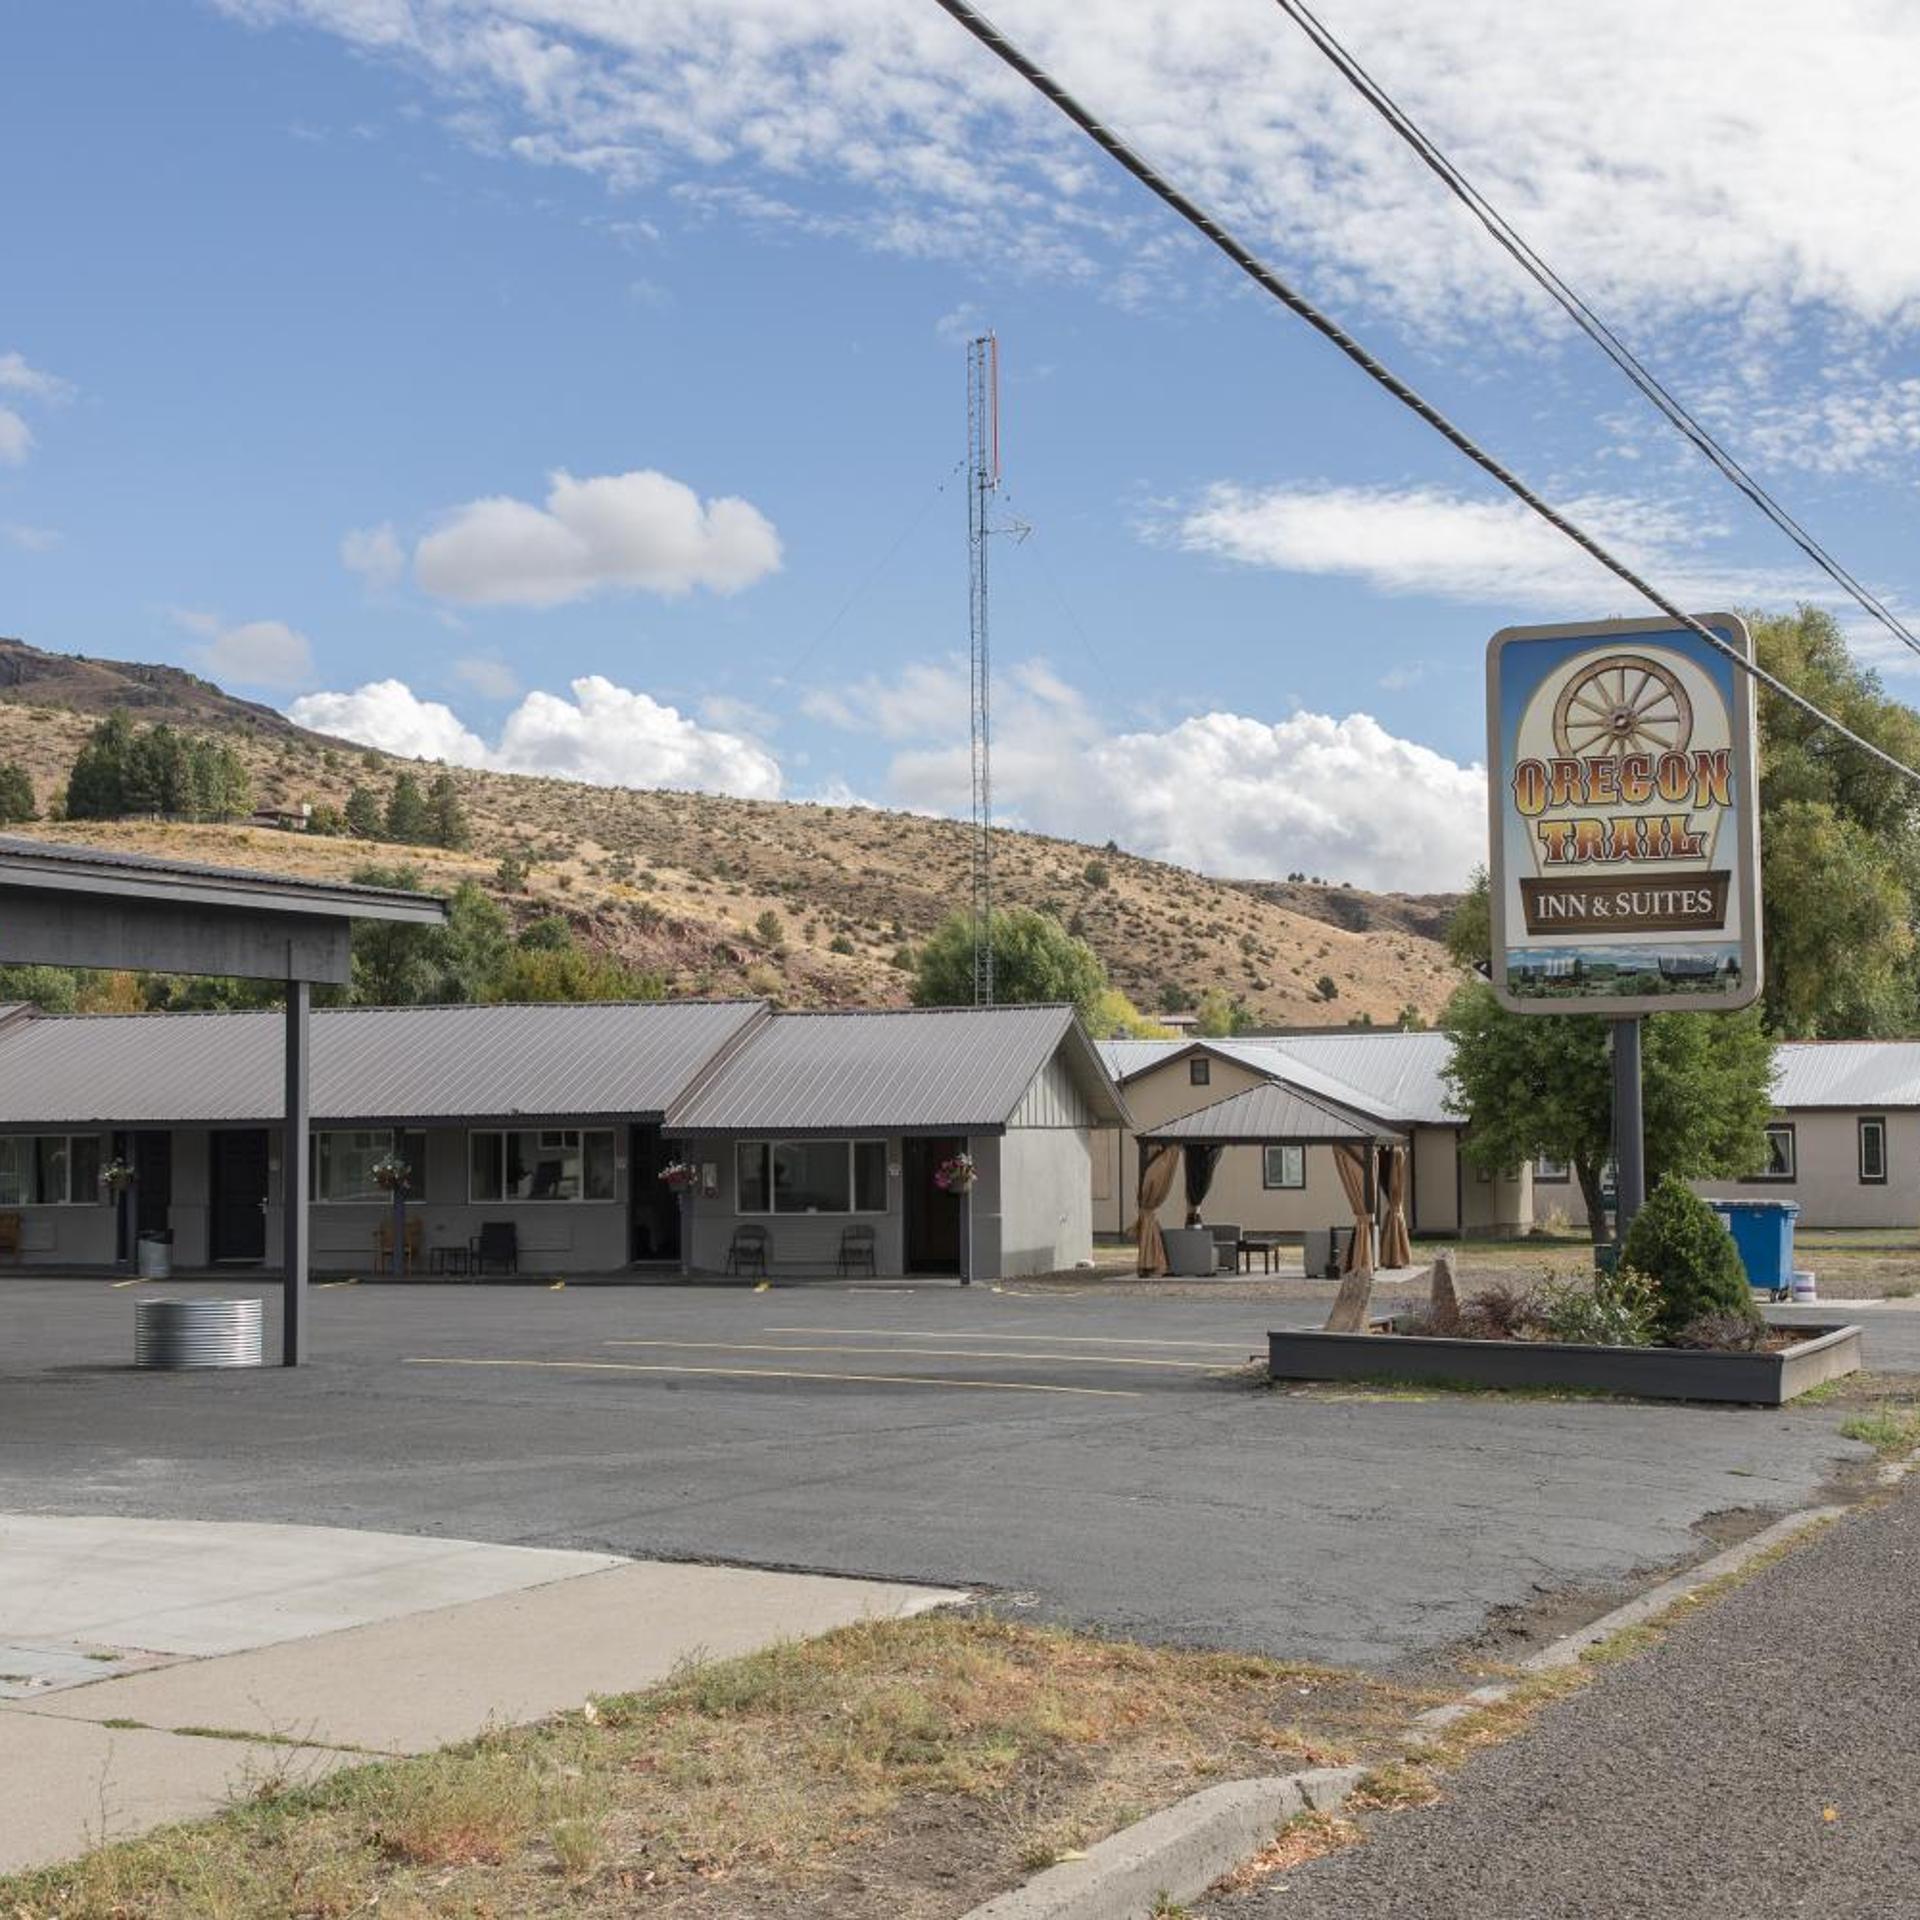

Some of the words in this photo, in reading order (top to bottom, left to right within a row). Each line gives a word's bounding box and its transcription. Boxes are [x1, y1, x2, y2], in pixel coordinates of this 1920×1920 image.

[1512, 749, 1732, 817] OREGON
[1537, 814, 1707, 866] TRAIL
[1537, 893, 1586, 919] INN
[1592, 895, 1611, 917] &
[1615, 888, 1713, 915] SUITES
